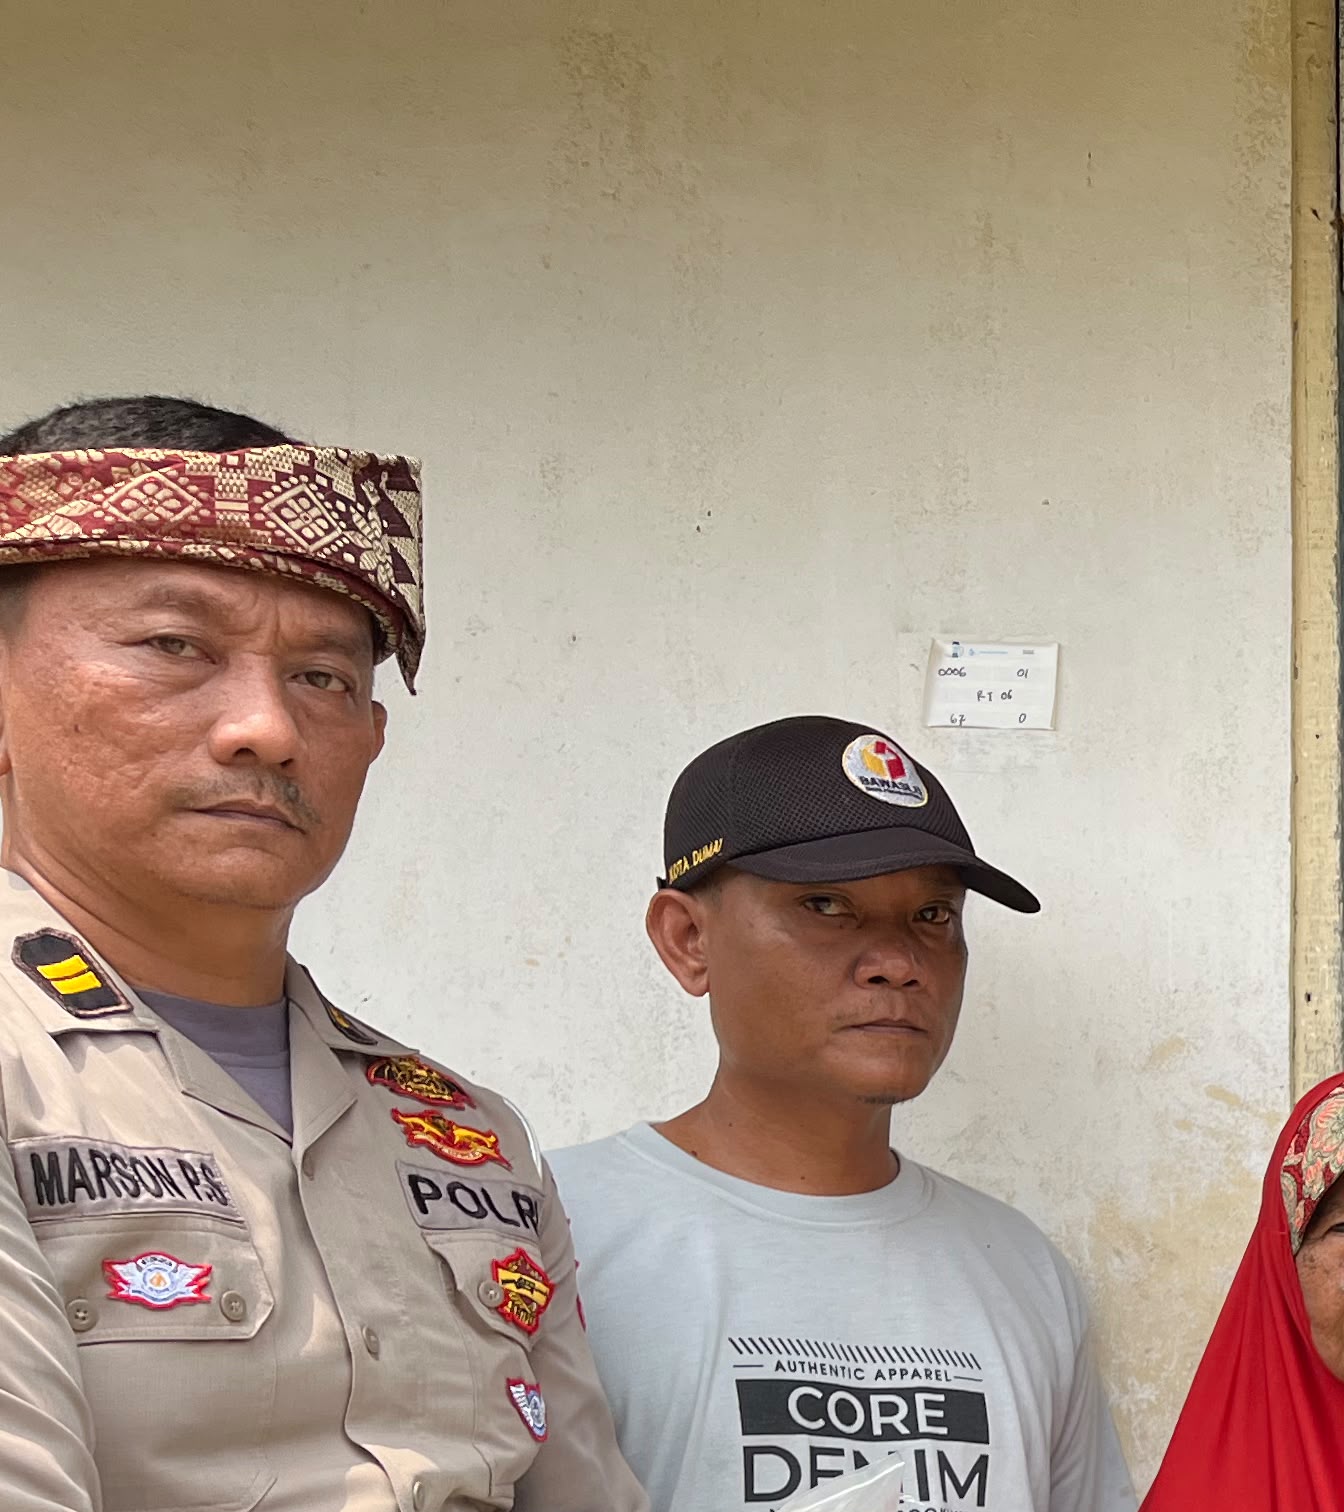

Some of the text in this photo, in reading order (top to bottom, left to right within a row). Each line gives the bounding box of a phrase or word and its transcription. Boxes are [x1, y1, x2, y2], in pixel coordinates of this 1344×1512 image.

[977, 689, 1013, 702] RT 06
[30, 1147, 187, 1207] MARSON
[774, 1360, 952, 1382] AUTHENTIC APPAREL
[787, 1386, 949, 1437] CORE
